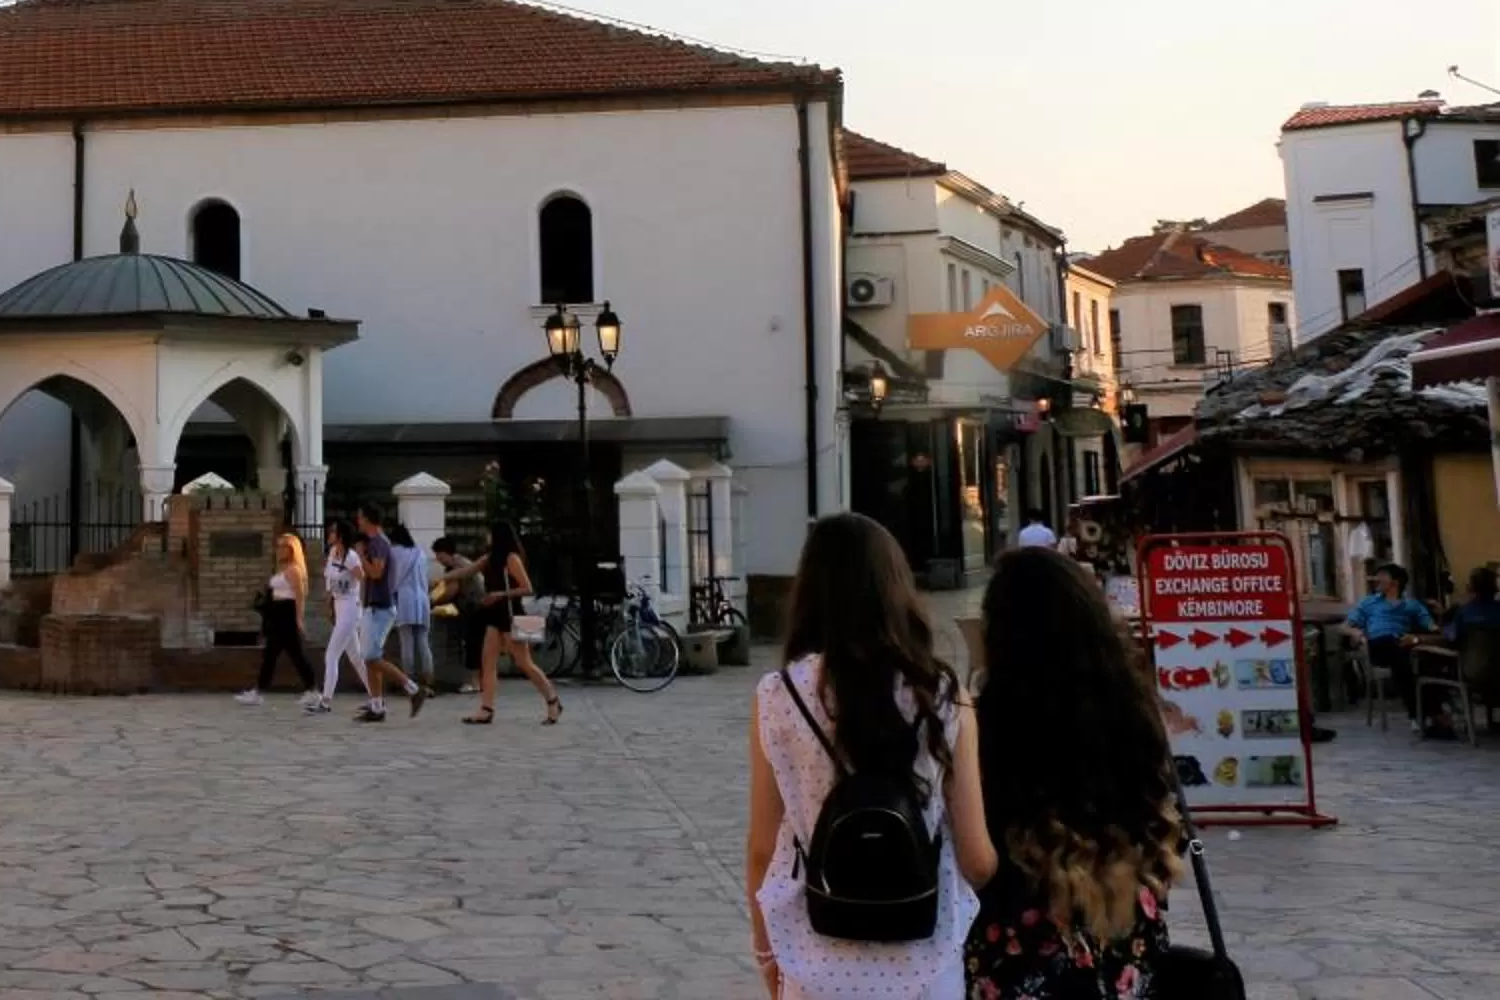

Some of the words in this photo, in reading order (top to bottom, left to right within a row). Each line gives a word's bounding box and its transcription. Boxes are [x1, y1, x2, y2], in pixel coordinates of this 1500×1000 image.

[1211, 548, 1269, 569] BÜROSU
[1155, 577, 1230, 595] EXCHANGE
[1233, 575, 1283, 593] OFFICE
[1177, 596, 1264, 617] KËMBIMORE
